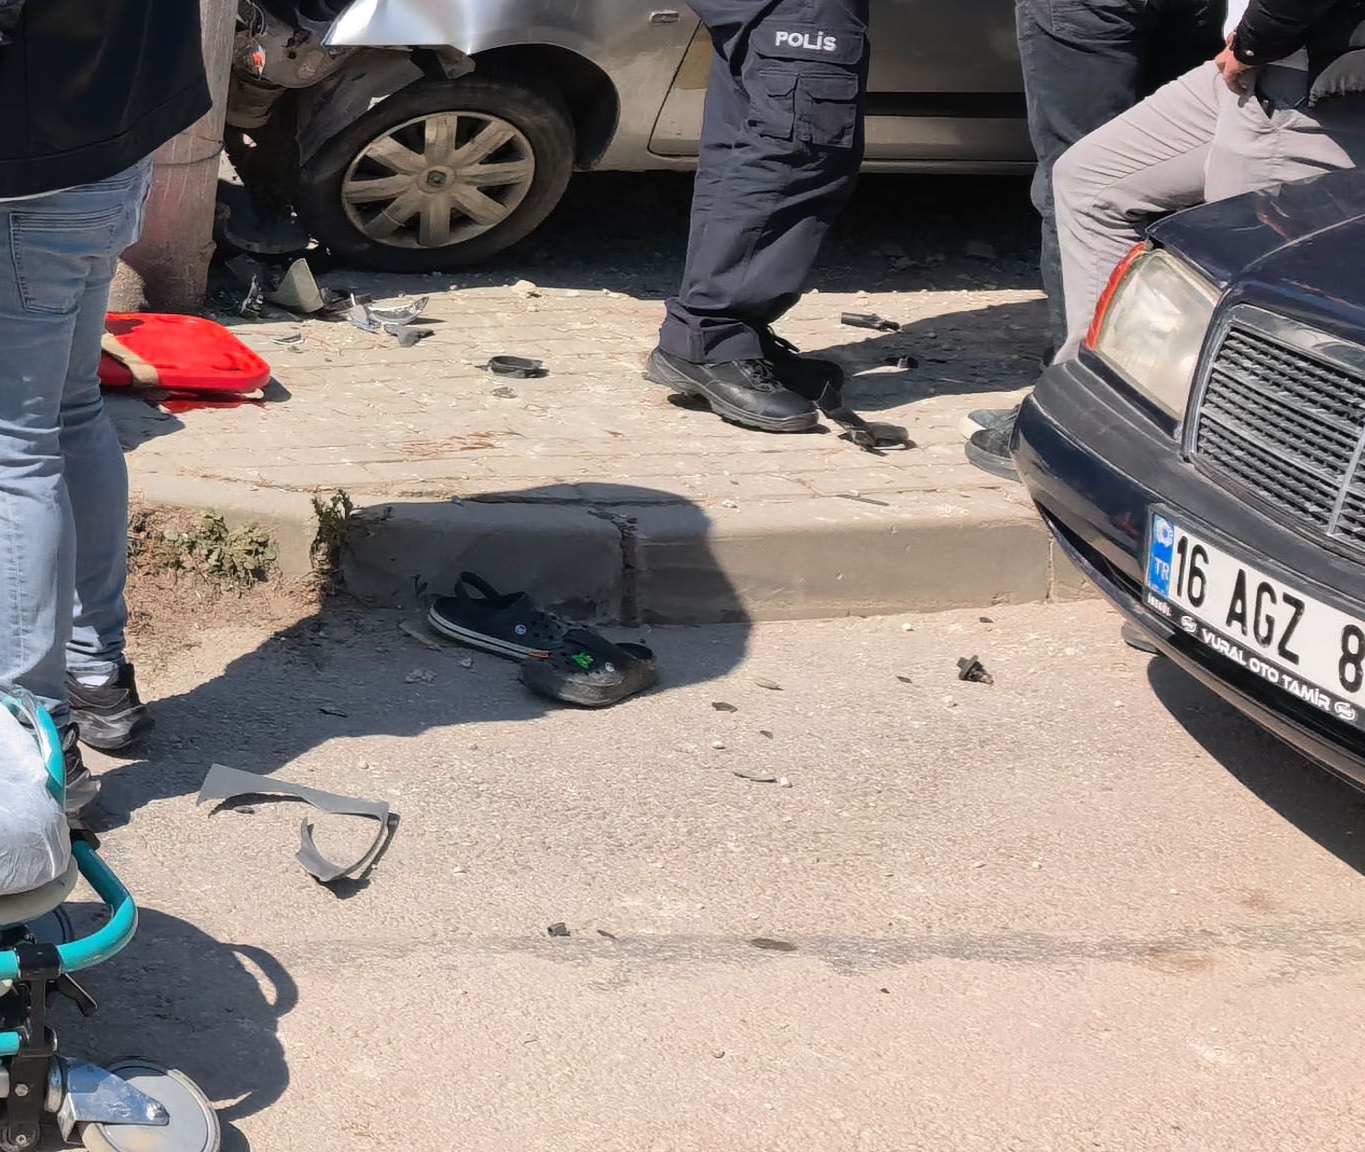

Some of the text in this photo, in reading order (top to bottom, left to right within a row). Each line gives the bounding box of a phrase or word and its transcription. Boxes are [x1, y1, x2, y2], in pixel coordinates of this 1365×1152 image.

[1154, 556, 1170, 581] TR
[1177, 535, 1365, 693] 16 AGZ 8
[1201, 628, 1332, 711] VURAL OTO TAMİR
